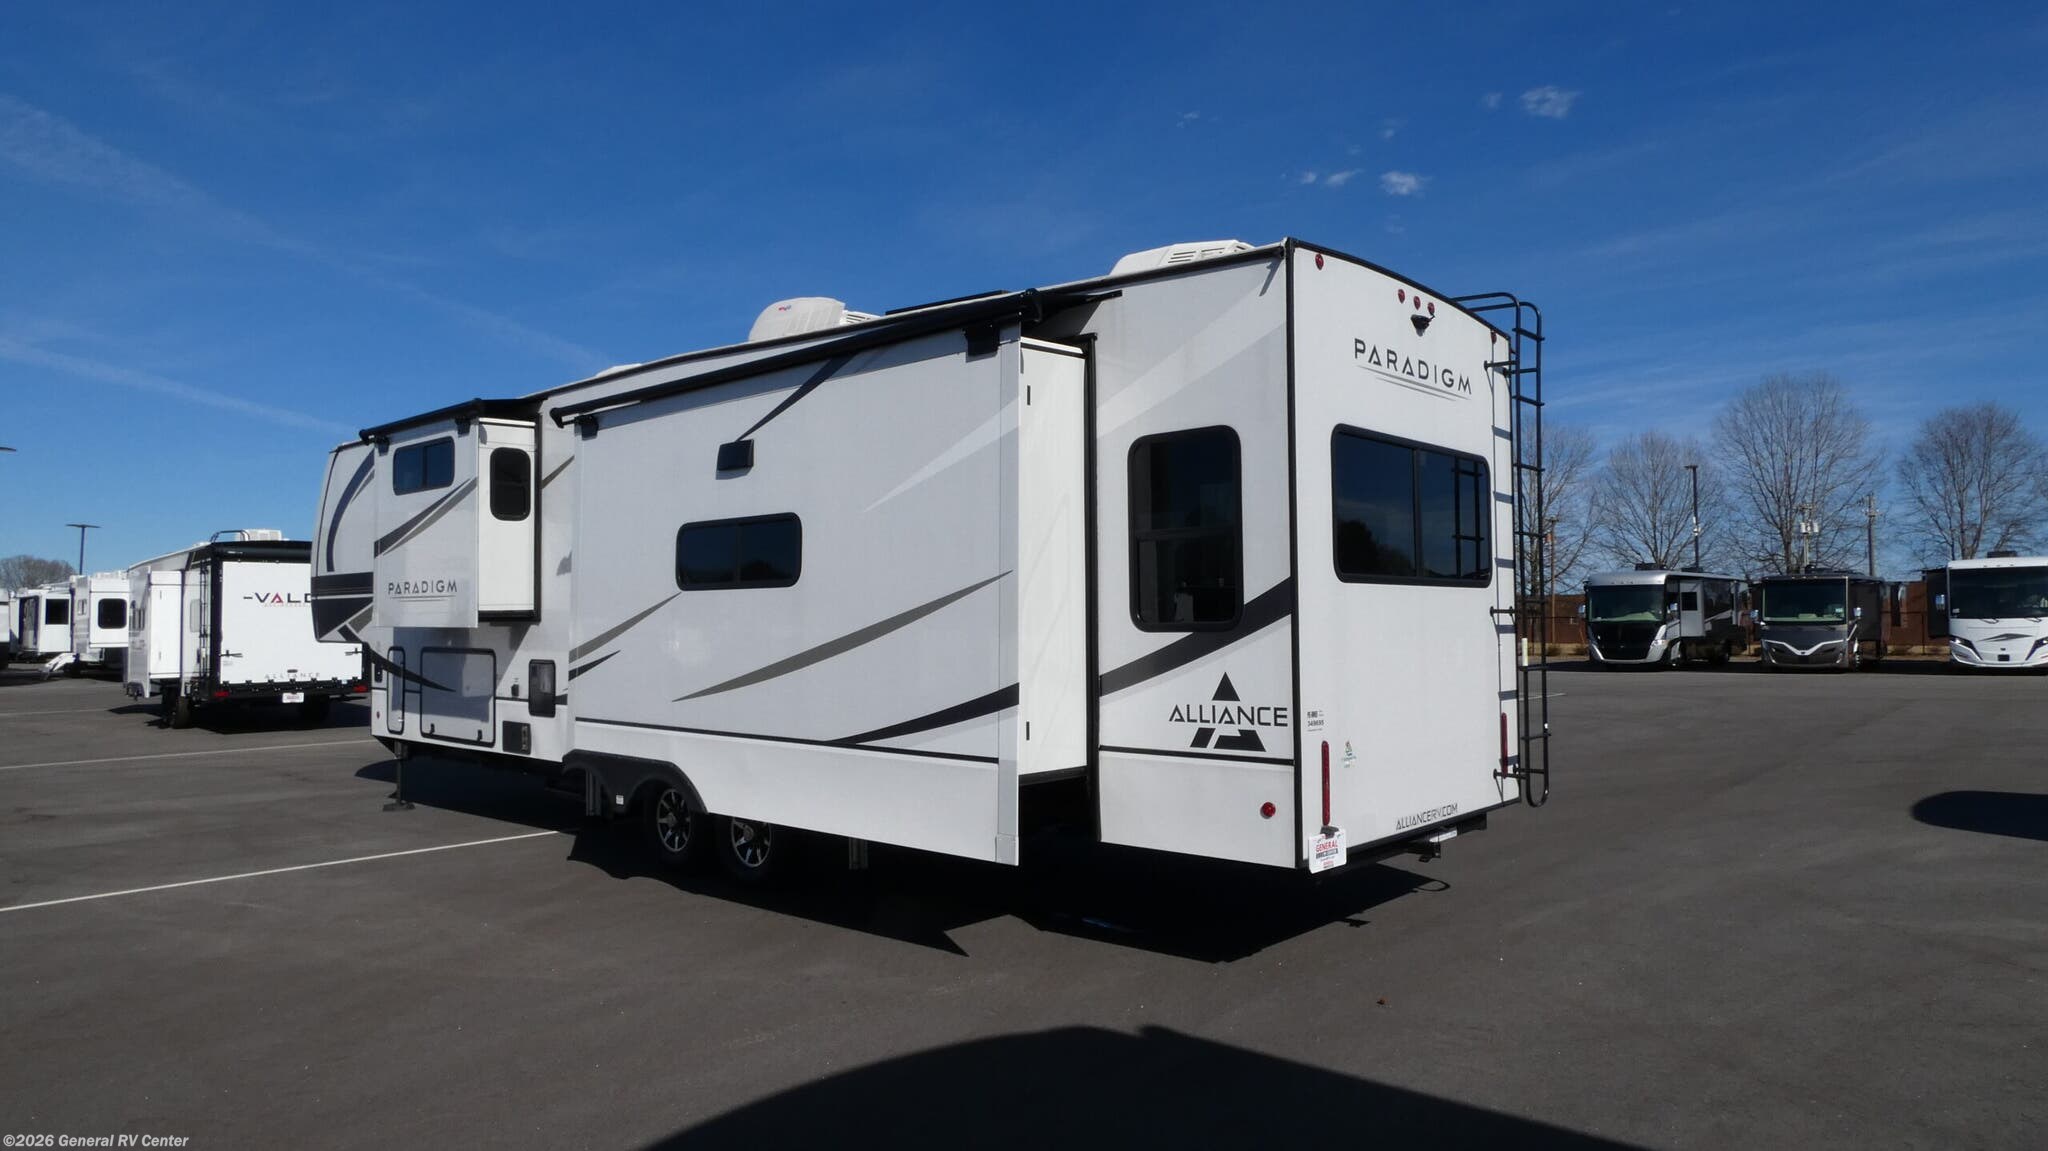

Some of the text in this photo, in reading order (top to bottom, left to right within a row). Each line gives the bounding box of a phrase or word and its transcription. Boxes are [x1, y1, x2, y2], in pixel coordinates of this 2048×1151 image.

[1354, 338, 1472, 395] PARADIGM
[387, 580, 458, 595] PARADIGM
[1168, 704, 1288, 727] ALLIANCE
